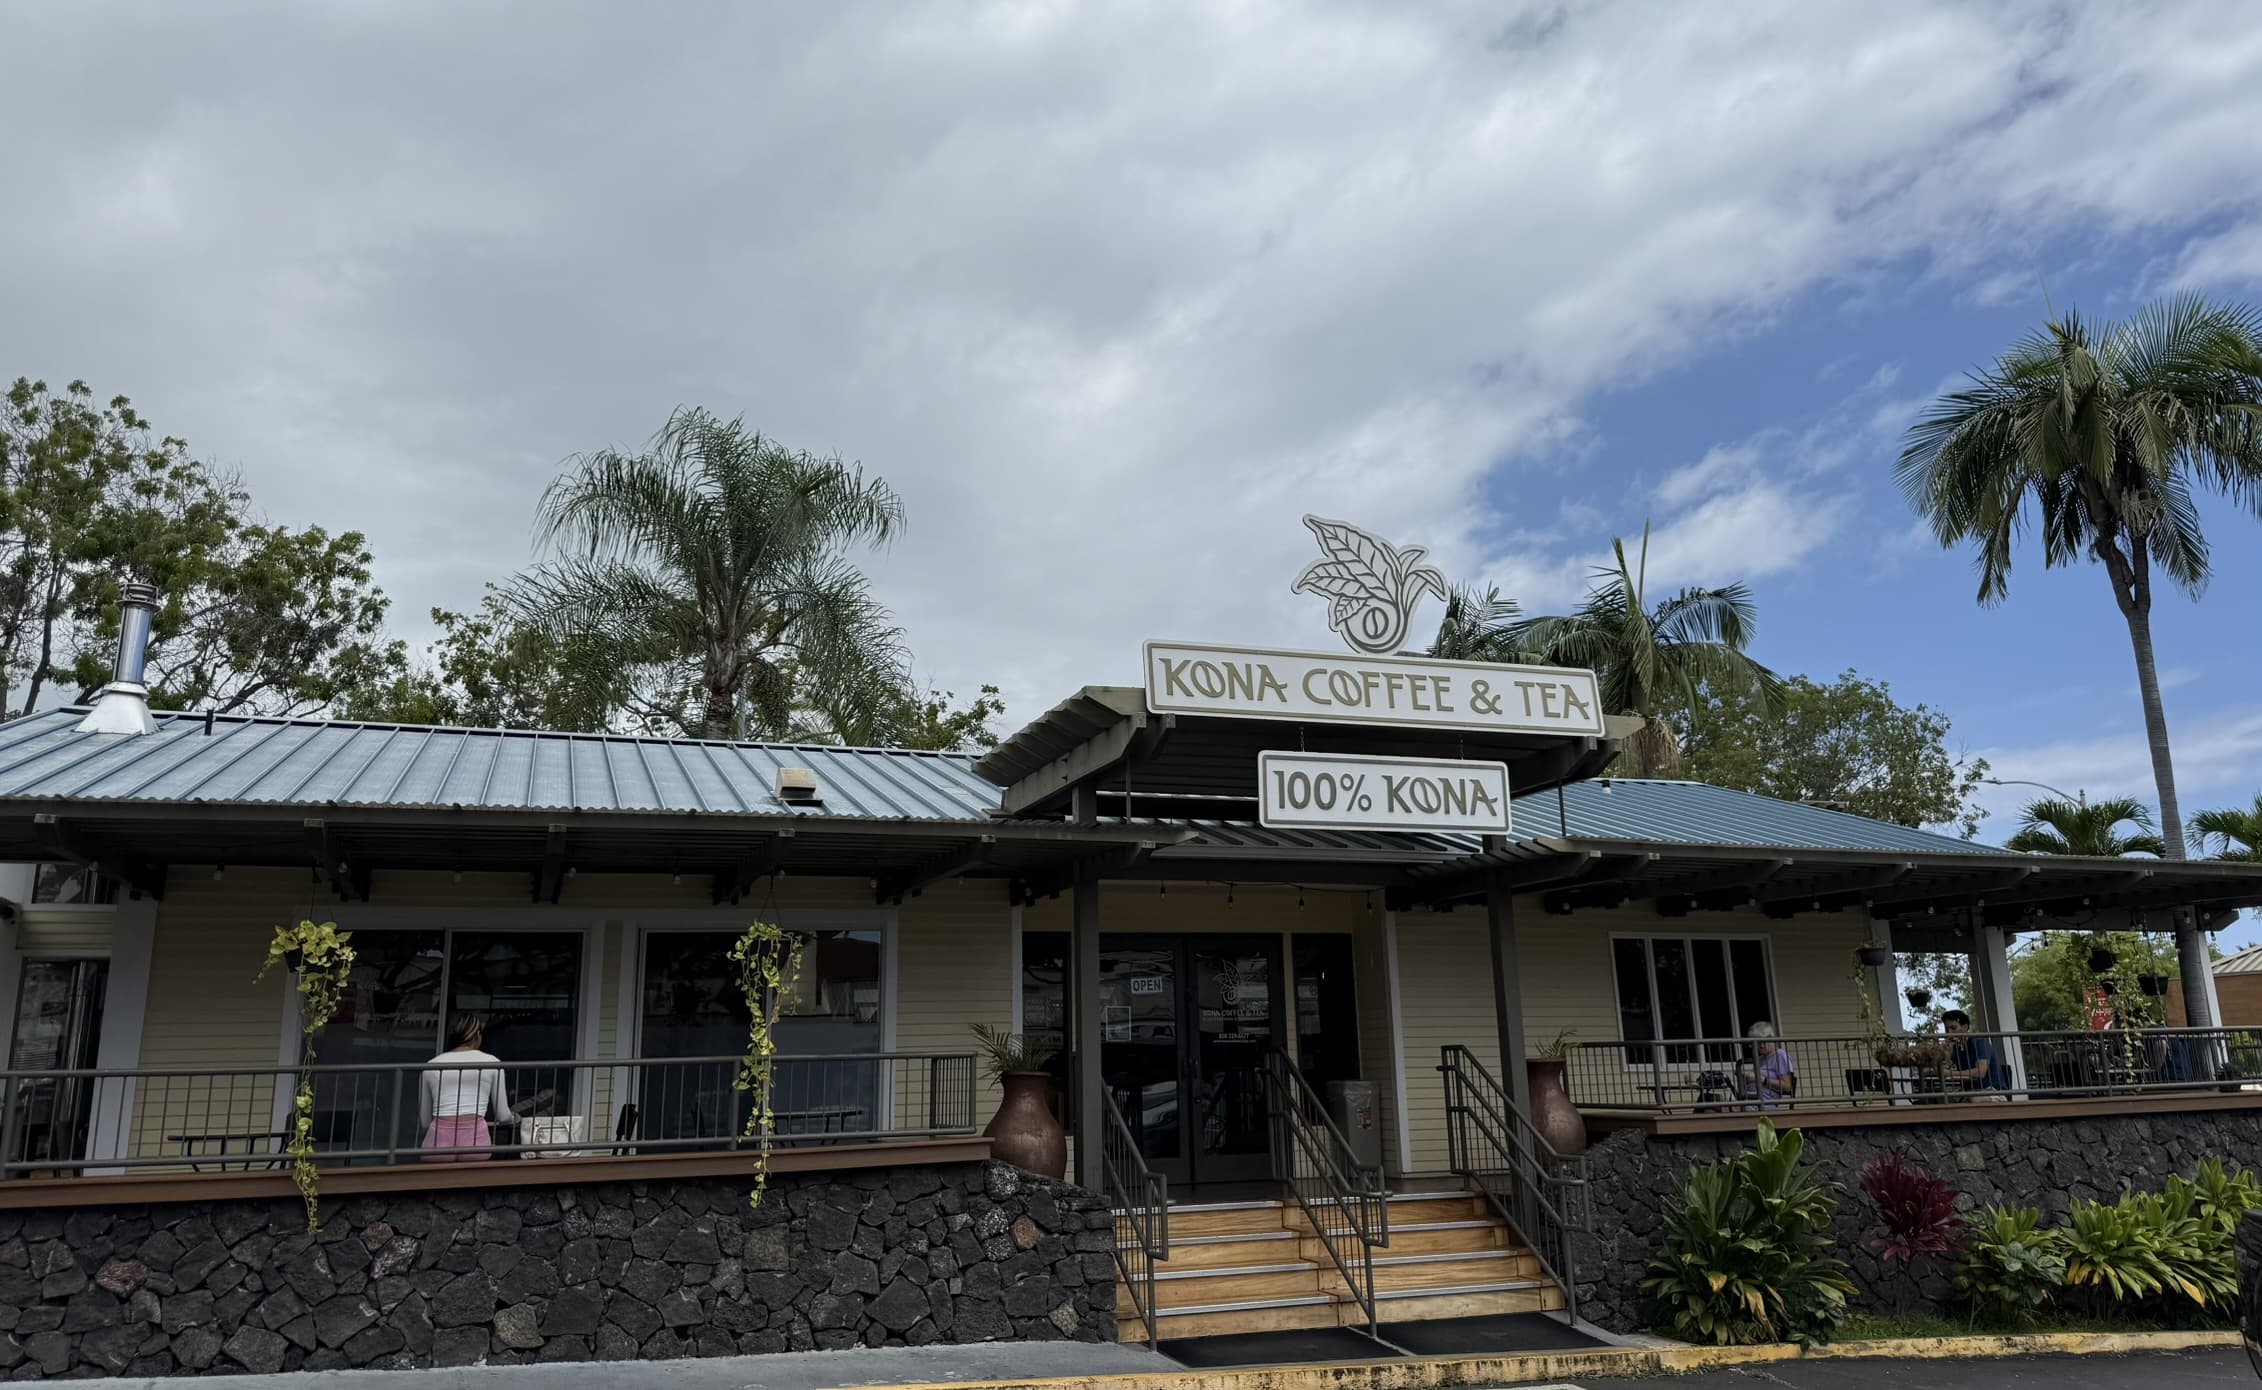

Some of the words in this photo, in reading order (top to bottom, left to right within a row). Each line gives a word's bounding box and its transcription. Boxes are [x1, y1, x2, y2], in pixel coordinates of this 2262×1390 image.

[1158, 657, 1288, 703] KONA
[1302, 667, 1455, 713] COFFEE
[1470, 679, 1503, 715] &
[1513, 680, 1590, 720] TEA
[1272, 770, 1372, 812] 100%
[1381, 774, 1498, 817] KONA
[1132, 979, 1161, 992] OPEN
